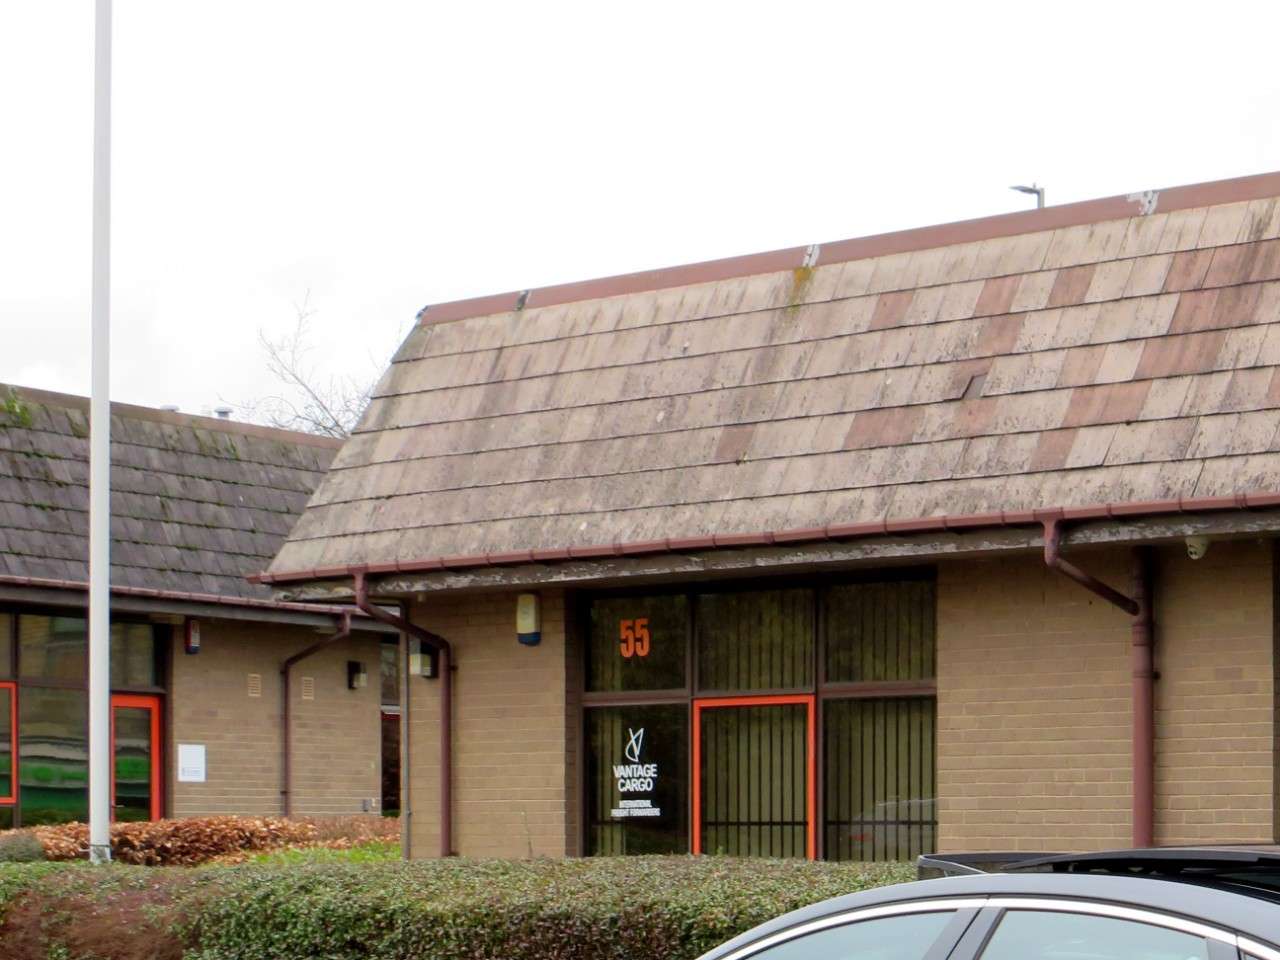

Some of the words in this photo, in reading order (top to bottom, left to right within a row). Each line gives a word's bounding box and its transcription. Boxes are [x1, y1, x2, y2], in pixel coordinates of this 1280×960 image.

[620, 618, 650, 657] 55
[613, 764, 658, 778] VANTAGE
[618, 778, 653, 792] CARGO
